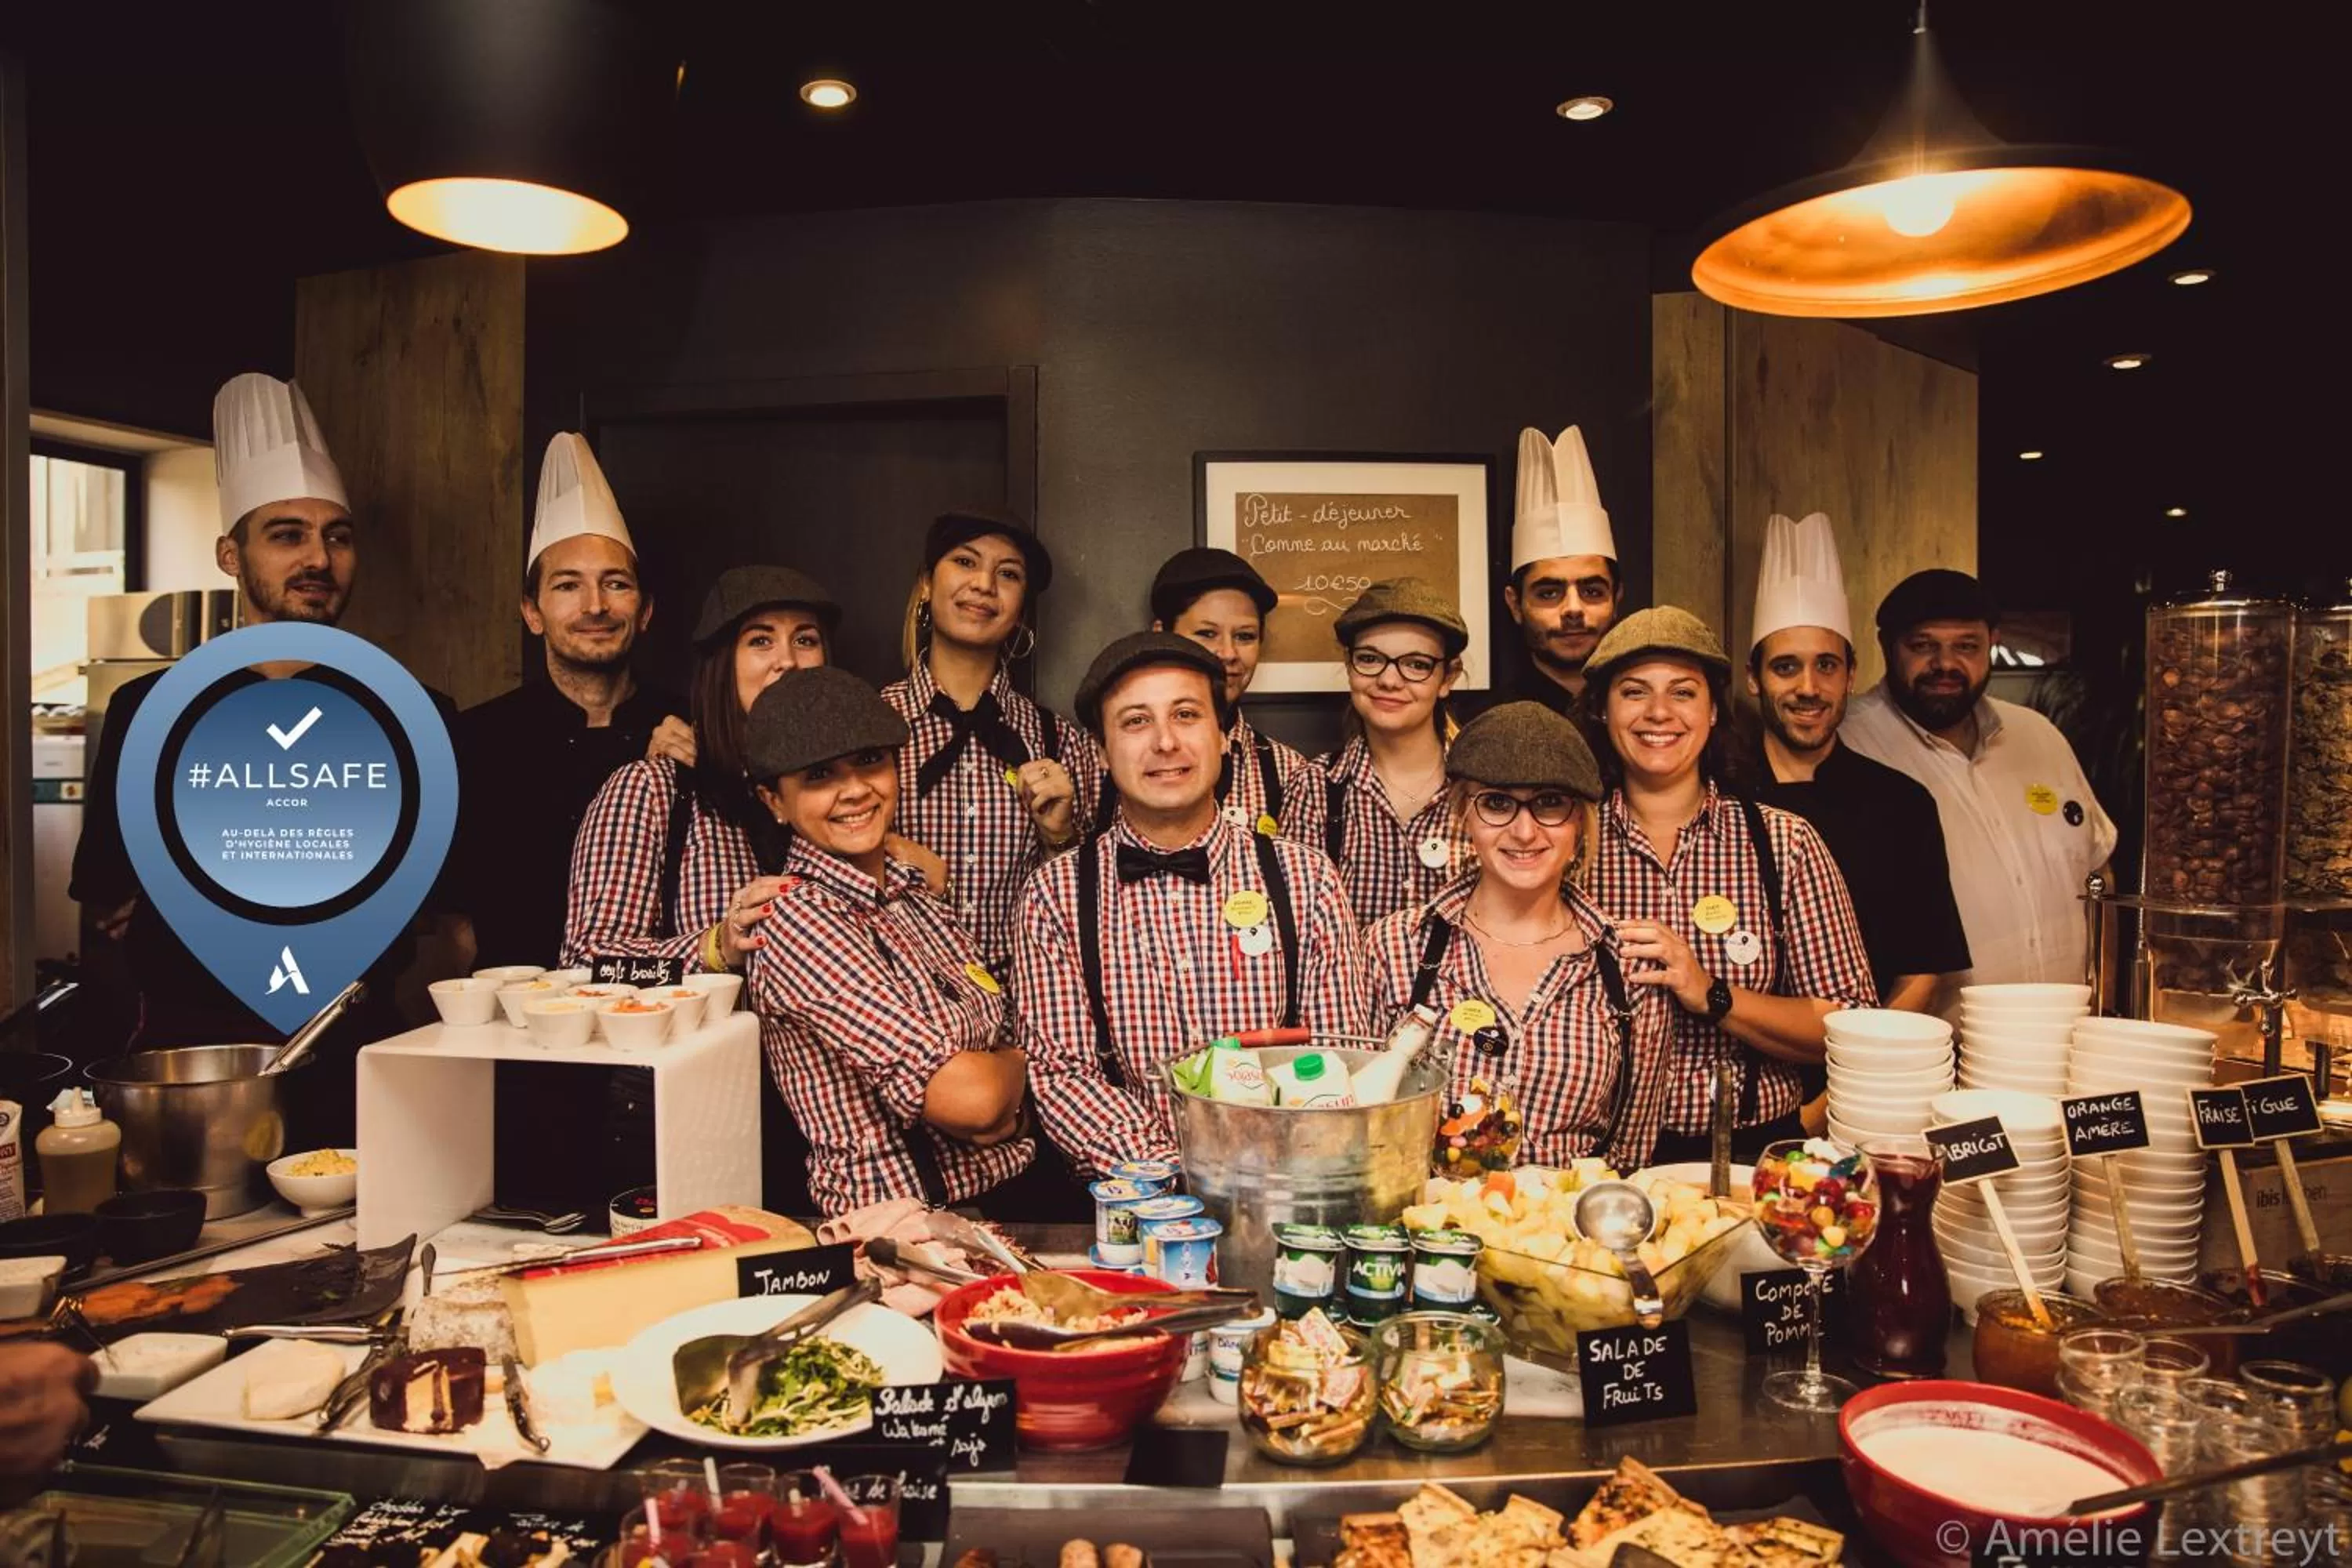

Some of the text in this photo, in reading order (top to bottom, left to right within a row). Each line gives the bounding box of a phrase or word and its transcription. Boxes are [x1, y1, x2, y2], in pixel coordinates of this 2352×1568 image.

[1243, 493, 1293, 528] Petit
[1320, 538, 1350, 553] au
[2067, 1097, 2136, 1119] ORANGE
[753, 1269, 831, 1295] JAMBON
[1780, 1304, 1804, 1321] DE
[1589, 1336, 1668, 1363] SALADE
[1623, 1361, 1646, 1381] DE
